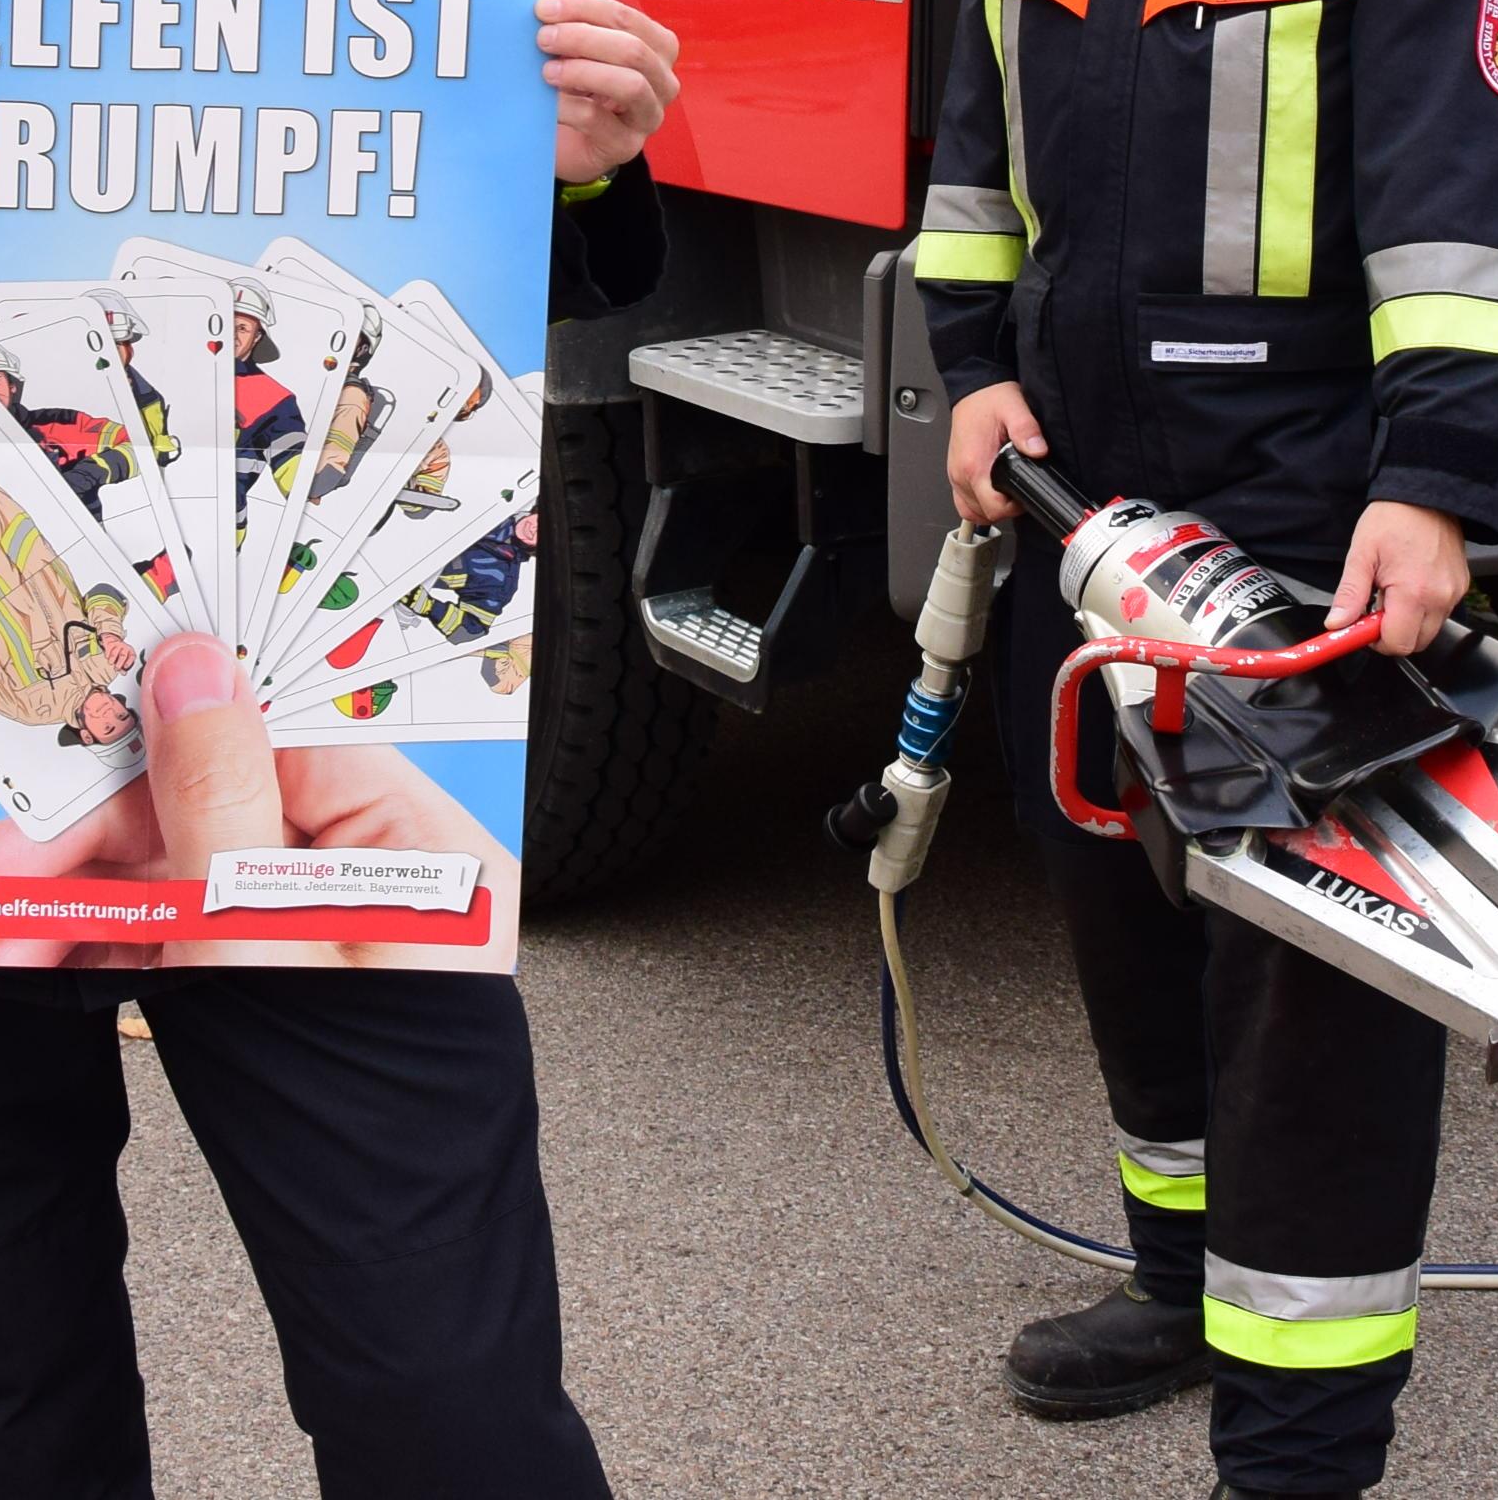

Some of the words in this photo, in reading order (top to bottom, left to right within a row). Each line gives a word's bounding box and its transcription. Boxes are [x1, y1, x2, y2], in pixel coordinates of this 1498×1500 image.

[1191, 565, 1210, 582] 60
[1173, 583, 1194, 607] EN
[1230, 583, 1286, 622] LUKAS
[235, 861, 335, 879] Freiwillige
[340, 862, 443, 880] Feuerwehr
[235, 880, 302, 892] Sicherheit.
[304, 881, 366, 893] Jederzeit.
[369, 882, 443, 895] Bayernweit.
[1305, 869, 1420, 937] LUKAS
